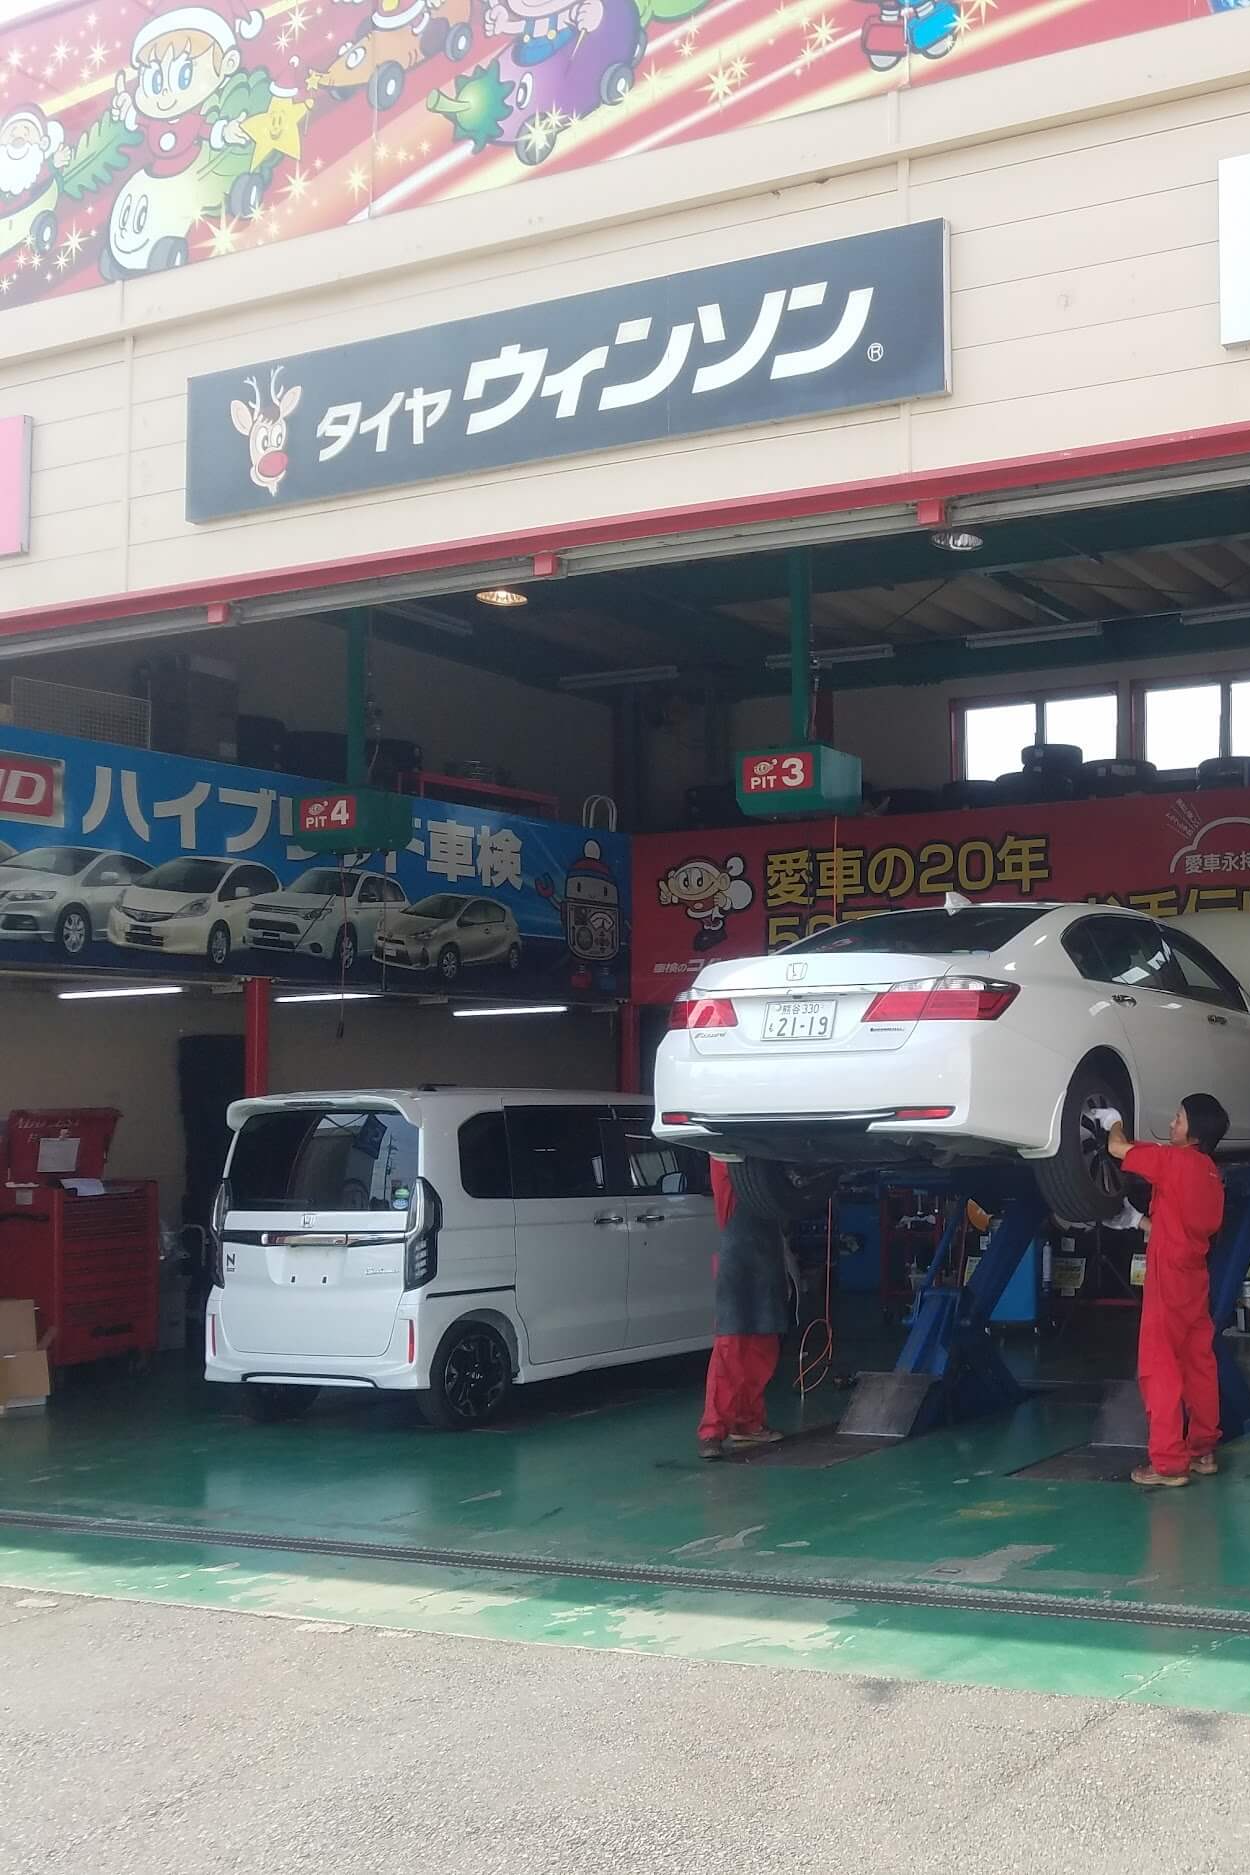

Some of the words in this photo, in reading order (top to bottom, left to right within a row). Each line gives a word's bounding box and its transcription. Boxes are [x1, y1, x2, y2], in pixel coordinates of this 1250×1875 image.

[750, 775, 777, 790] PIT
[781, 757, 805, 787] 3
[305, 815, 328, 829] PIT
[330, 799, 350, 825] 4
[767, 835, 1049, 907] 愛車の20年
[776, 1016, 829, 1037] 21-19
